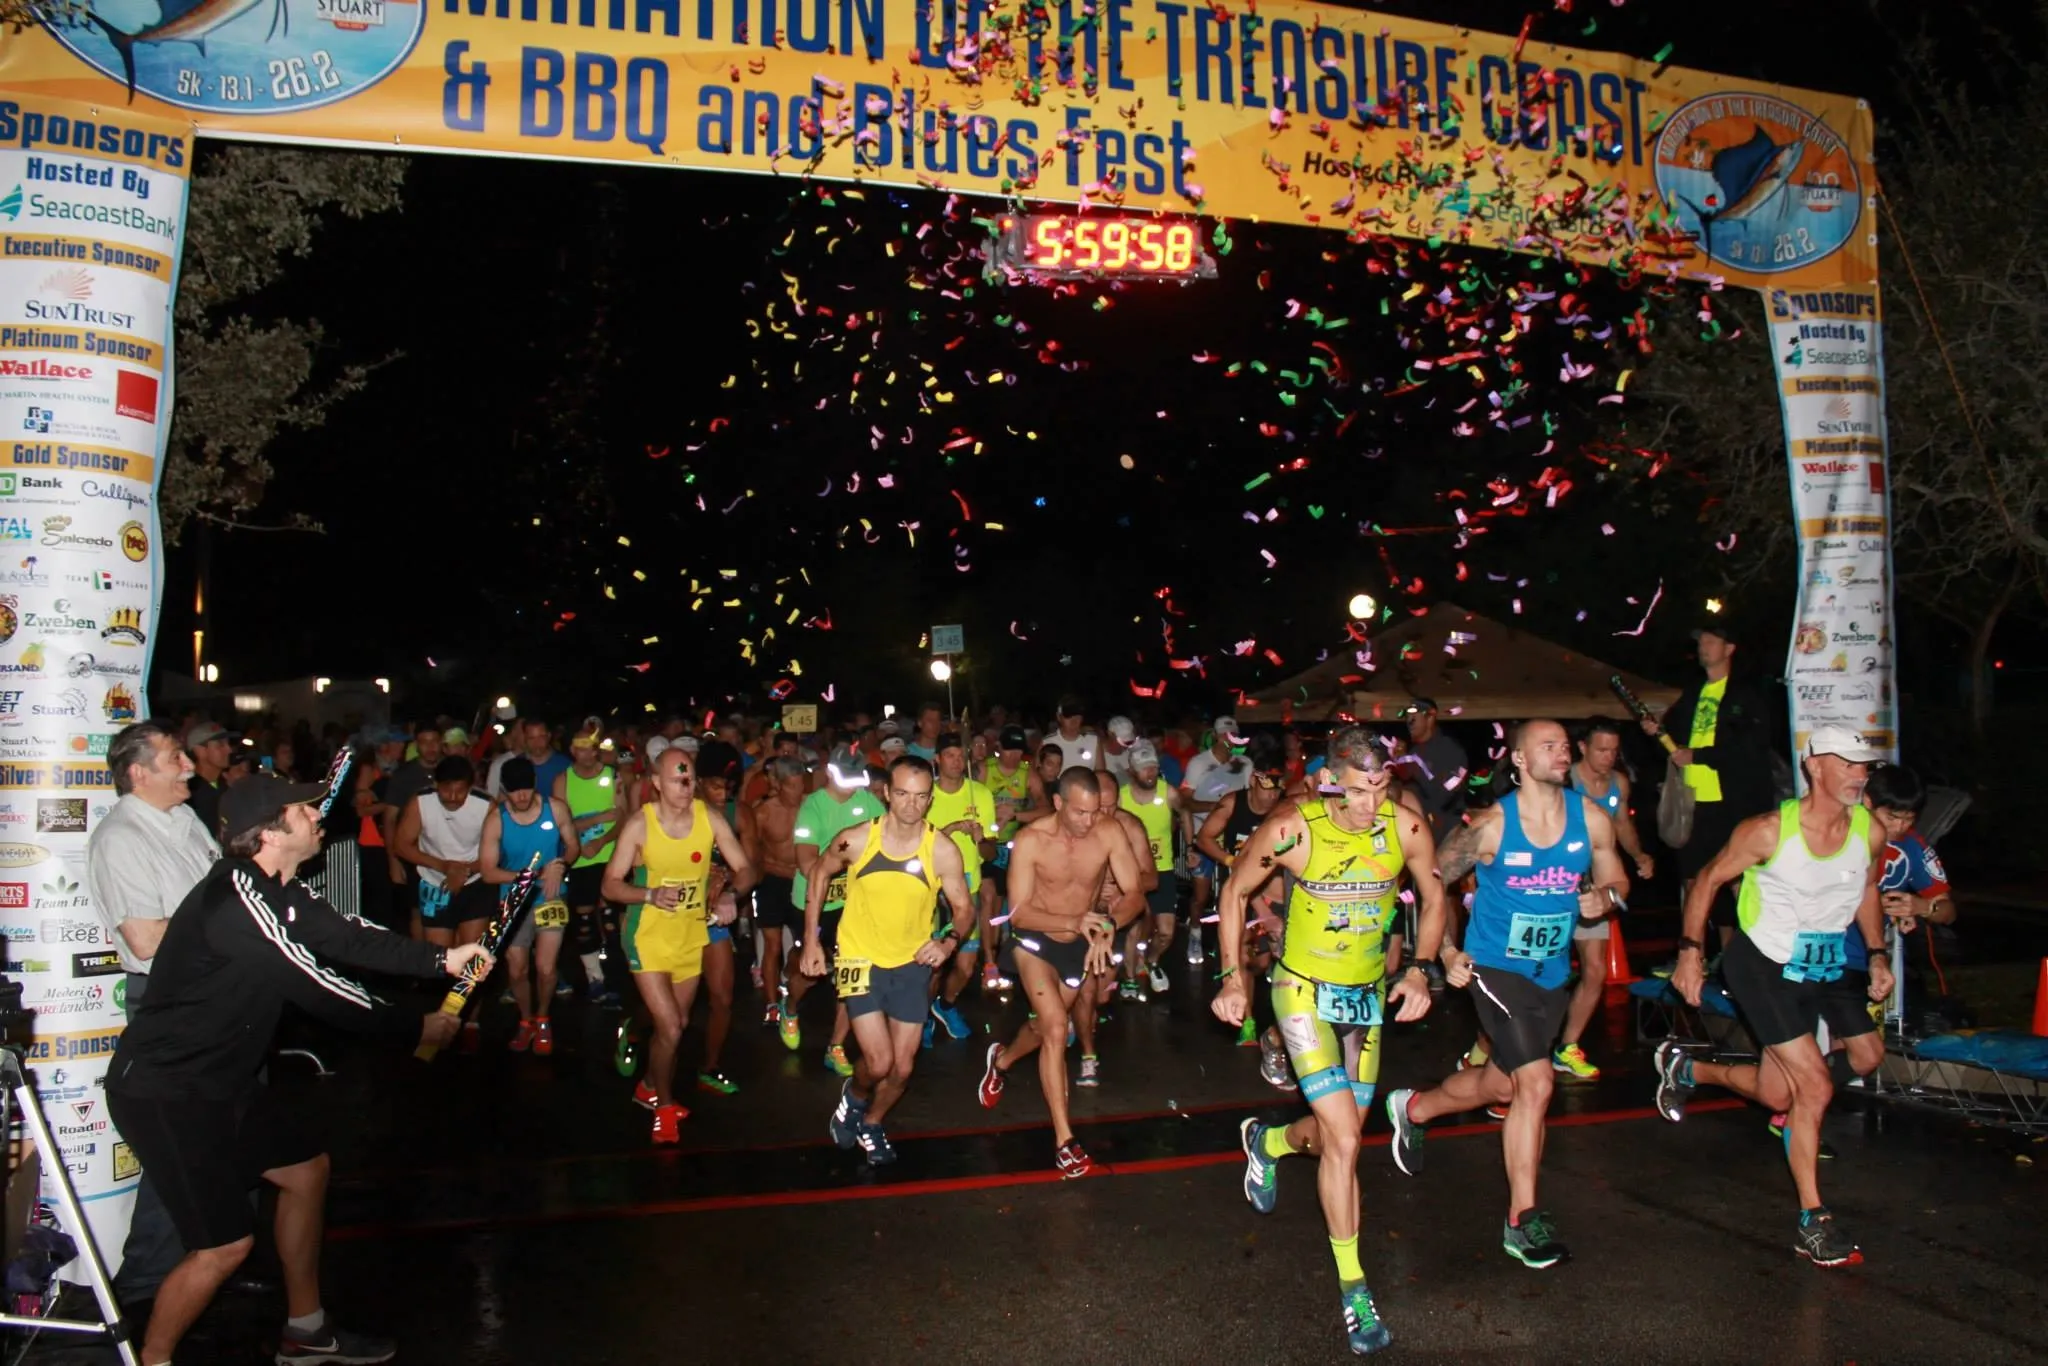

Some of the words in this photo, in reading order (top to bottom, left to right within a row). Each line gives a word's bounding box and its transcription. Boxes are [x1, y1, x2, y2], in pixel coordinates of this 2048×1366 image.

[318, 0, 381, 17] STUART
[220, 75, 254, 101] 13.1
[269, 50, 340, 100] 26.2
[1156, 1, 1461, 139] TREASURE
[443, 39, 491, 133] &
[520, 46, 669, 156] BBQ
[697, 76, 824, 160] and
[854, 82, 1039, 185] Blues
[1064, 105, 1193, 198] Fest
[0, 101, 184, 168] Sponsors
[27, 157, 113, 188] Hosted
[123, 164, 150, 199] By
[29, 195, 175, 241] SeacoastBank
[4, 236, 86, 261] Executive
[92, 241, 160, 273] Sponsor
[1037, 220, 1193, 271] 5:59:58
[1774, 227, 1816, 263] 26.2
[1772, 289, 1876, 320] Sponsors
[1, 328, 79, 349] Platinum
[85, 331, 152, 362] Sponsor
[1800, 324, 1846, 340] Hosted
[1848, 325, 1866, 342] By
[0, 358, 93, 380] Wallace
[13, 443, 52, 465] Gold
[57, 446, 129, 472] Sponsor
[1802, 461, 1859, 474] Wallace
[22, 477, 63, 489] Bank
[41, 530, 113, 547] Salcedo
[24, 613, 96, 630] Zweben
[1832, 632, 1876, 643] Zweben
[32, 705, 77, 716] Stuart
[0, 764, 43, 785] Silver
[53, 765, 114, 788] Sponso
[33, 898, 68, 909] Team
[73, 895, 89, 907] Fit
[60, 926, 100, 944] keg
[1521, 926, 1562, 948] 462
[1801, 943, 1837, 965] 111
[1332, 998, 1371, 1023] 550
[56, 1034, 121, 1060] Sponso
[59, 1120, 106, 1135] RoadID
